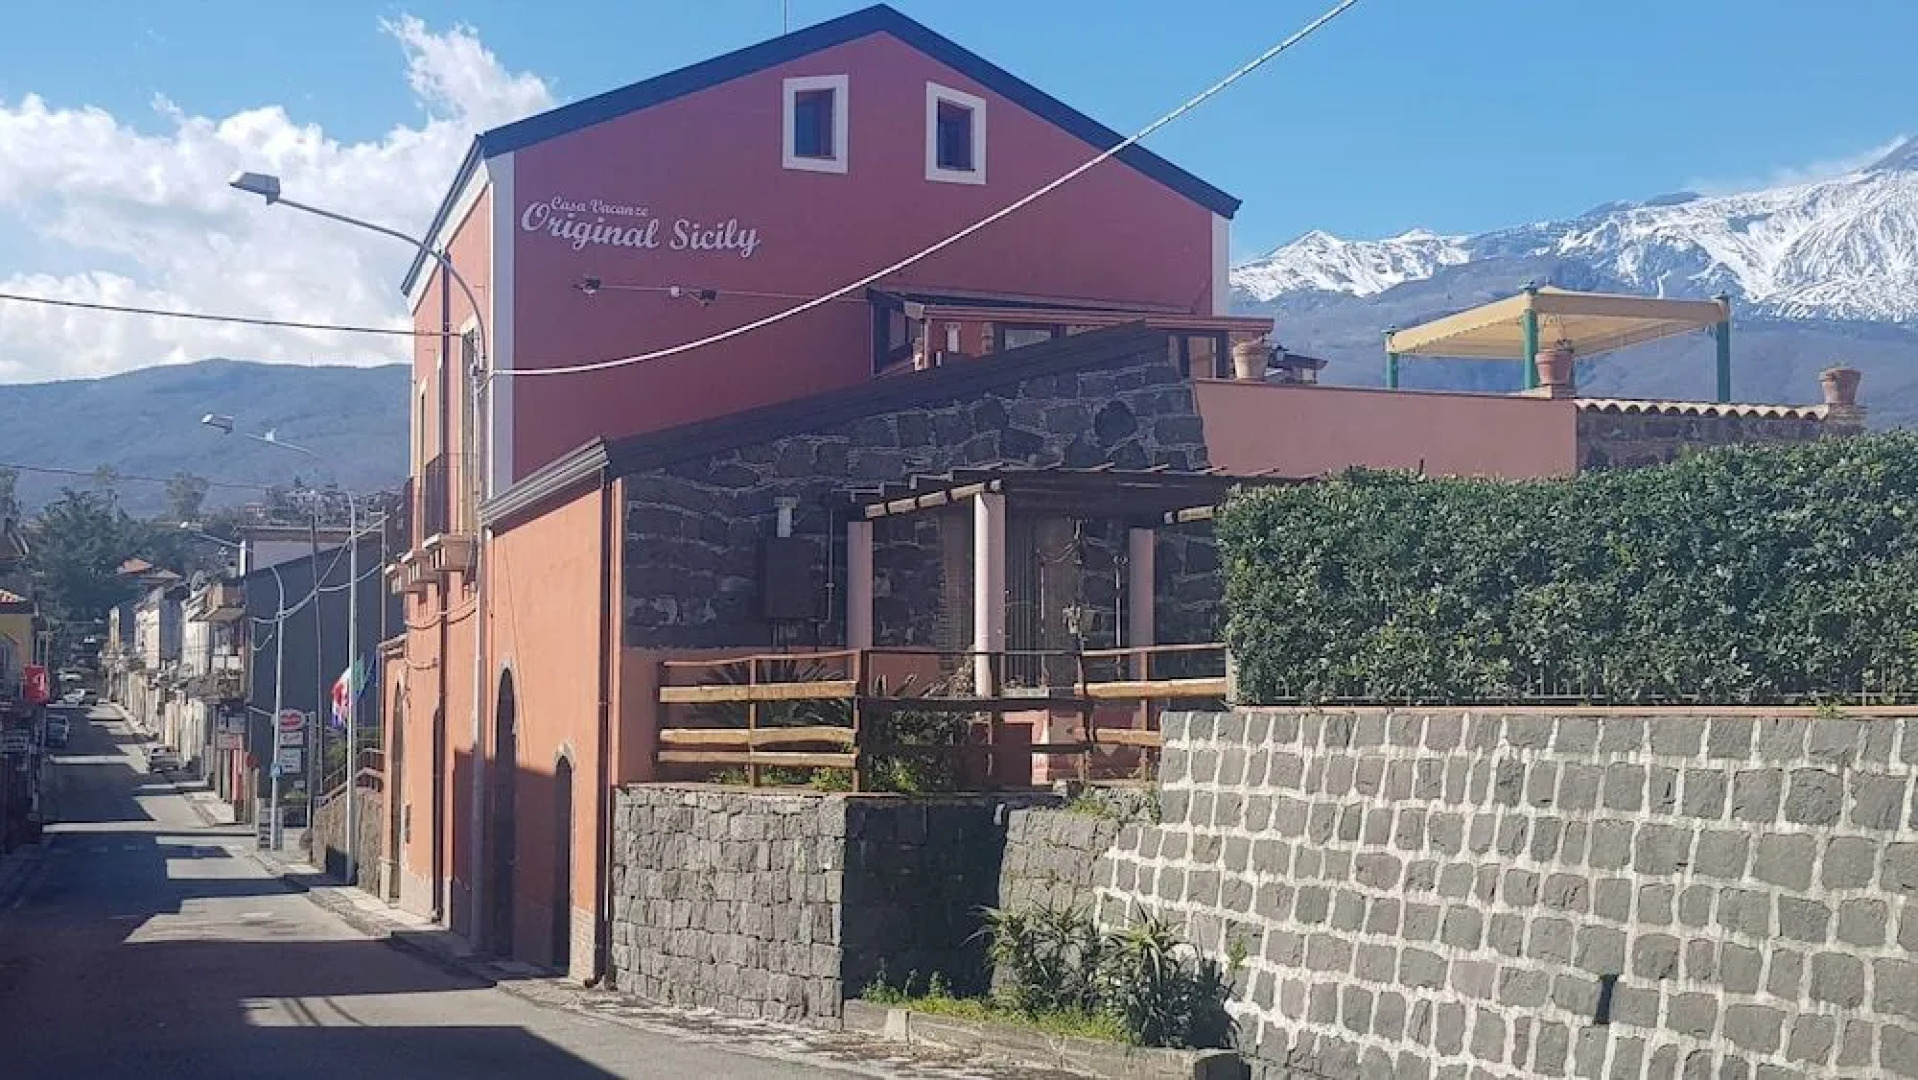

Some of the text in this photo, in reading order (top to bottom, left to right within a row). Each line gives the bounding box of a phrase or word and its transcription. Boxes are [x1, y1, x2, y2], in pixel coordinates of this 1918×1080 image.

[551, 196, 586, 212] Casa
[521, 202, 761, 258] Original Sicily
